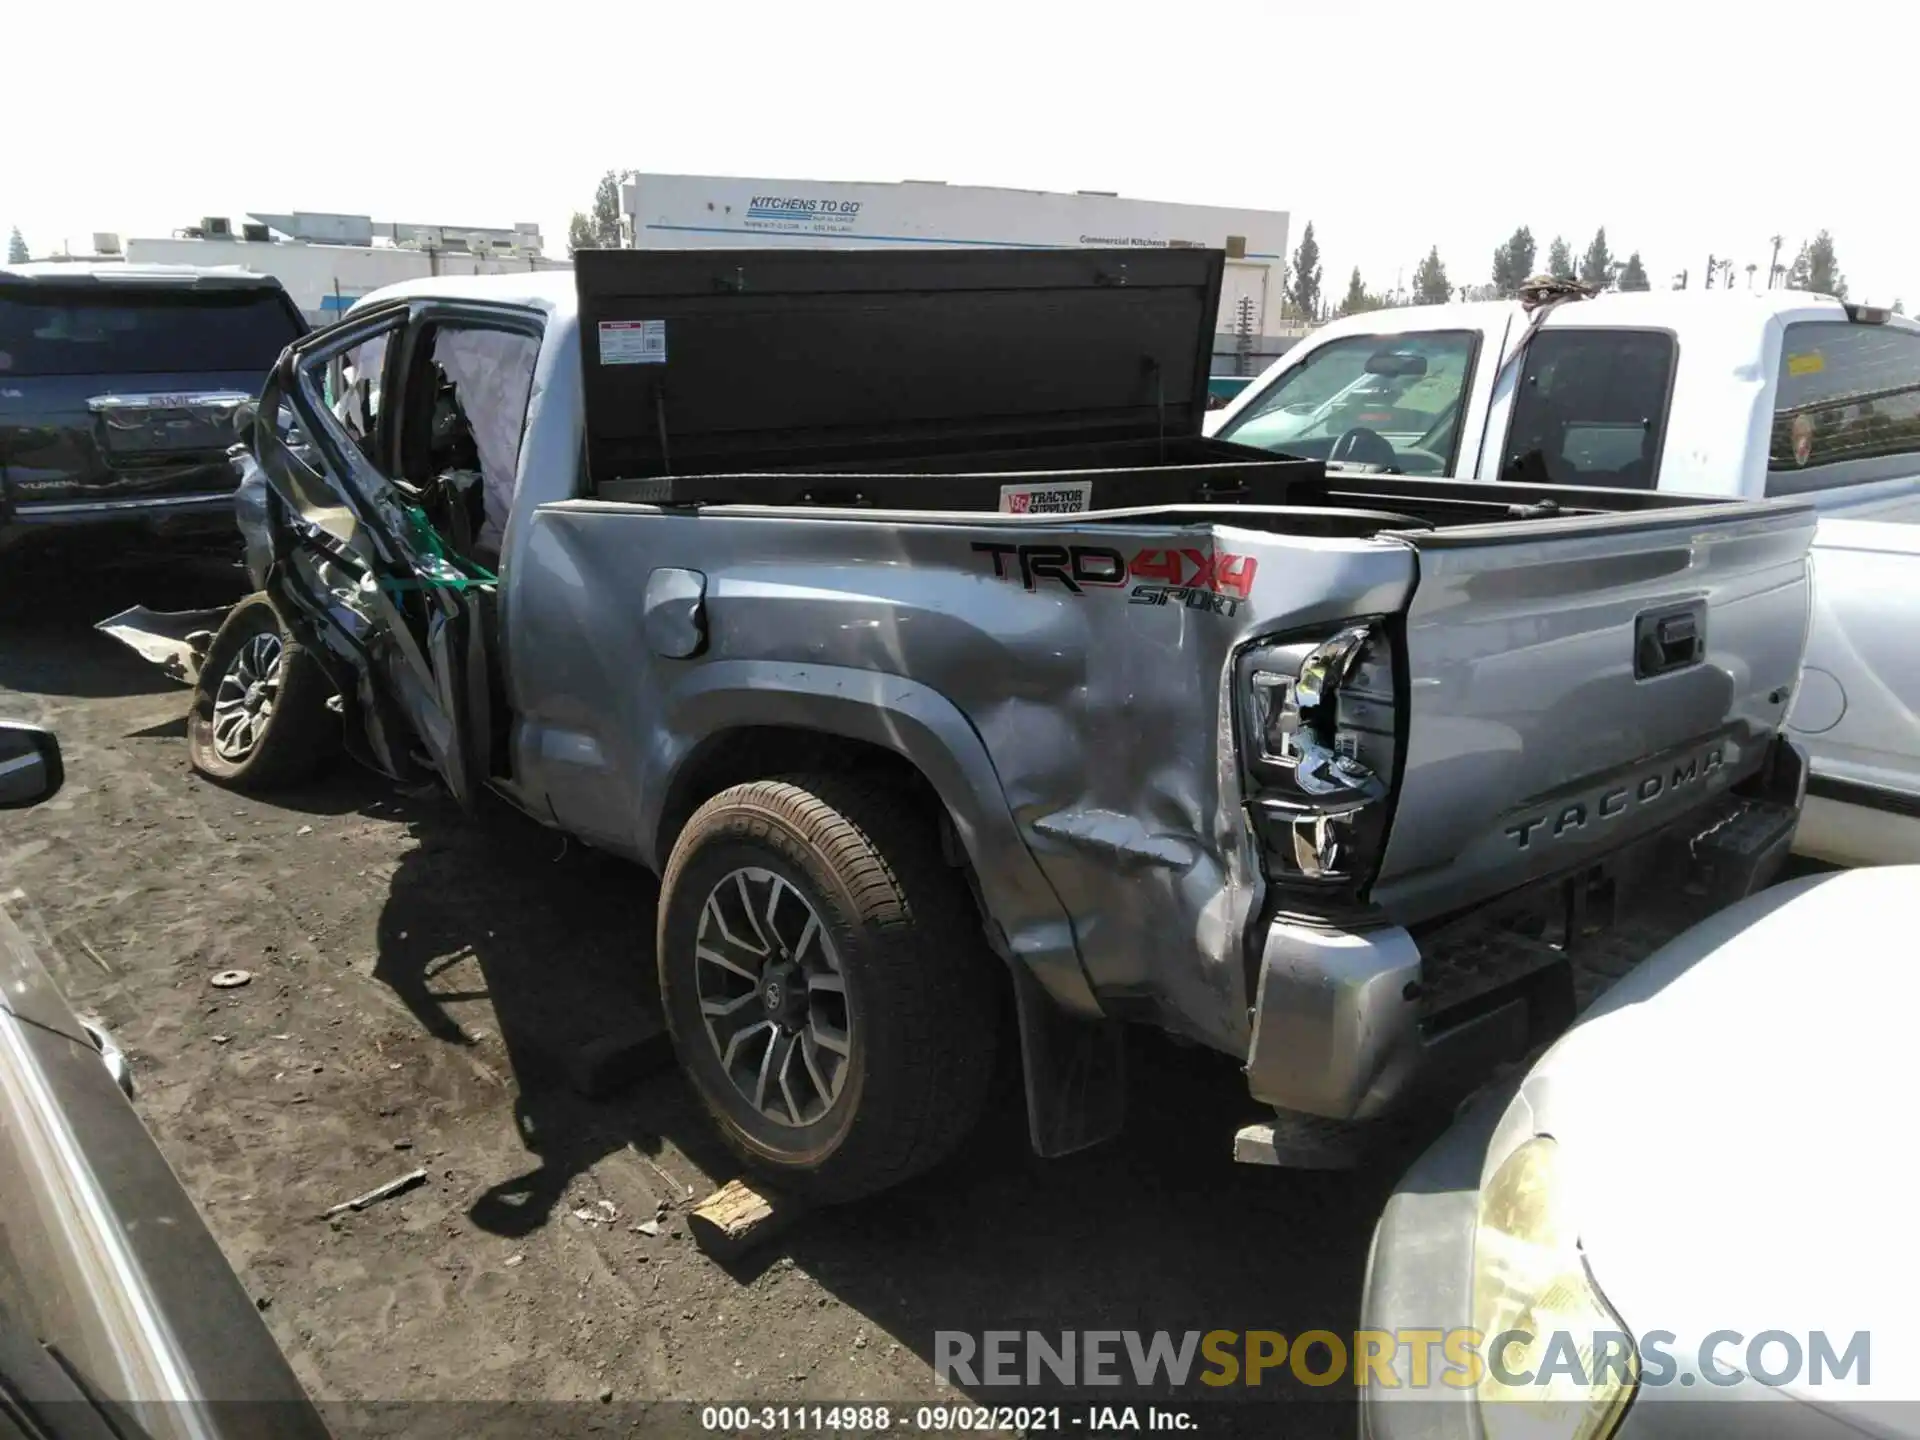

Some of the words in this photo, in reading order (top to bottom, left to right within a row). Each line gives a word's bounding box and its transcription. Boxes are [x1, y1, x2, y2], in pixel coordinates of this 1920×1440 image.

[750, 195, 817, 211] KITCHENS
[820, 199, 838, 211] TO
[840, 201, 860, 213] GO
[1079, 234, 1129, 246] Commercial
[1130, 237, 1167, 248] Kitchens
[1031, 489, 1083, 505] TRACTOR
[1029, 502, 1069, 513] SUPPLY
[971, 541, 1131, 597] TRD
[1128, 584, 1244, 618] SPORT
[1504, 748, 1725, 851] TACOMA
